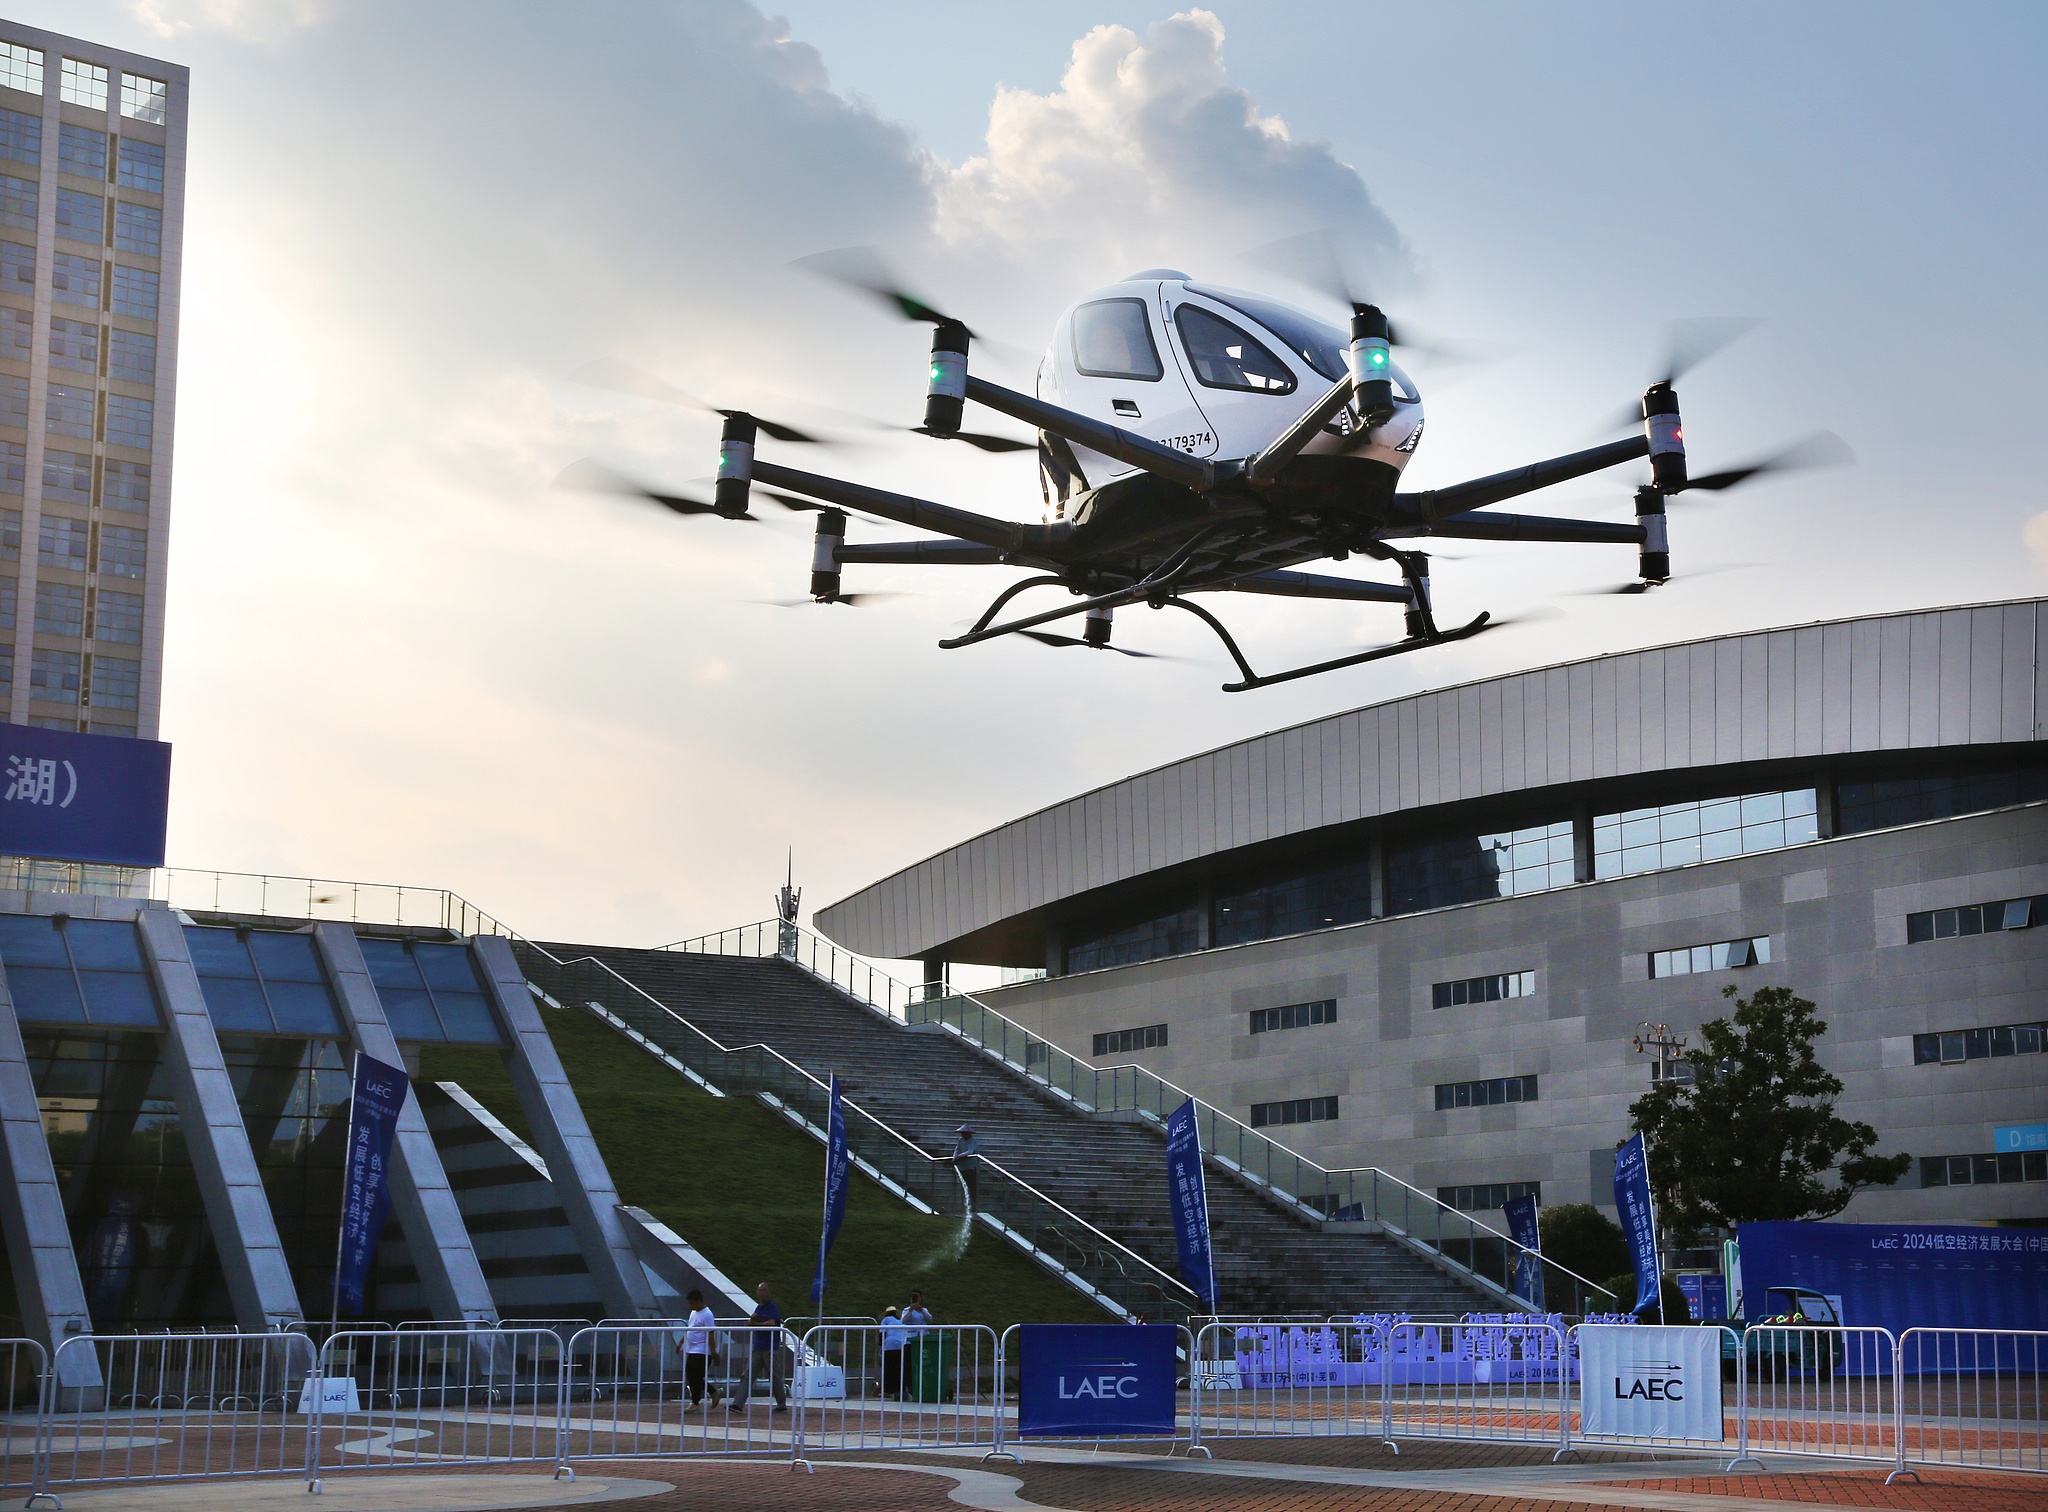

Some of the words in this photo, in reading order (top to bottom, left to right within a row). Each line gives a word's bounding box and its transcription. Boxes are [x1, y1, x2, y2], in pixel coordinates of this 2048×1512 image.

[366, 1079, 392, 1099] LAEC
[1172, 1119, 1188, 1137] LAEC
[2010, 1130, 2021, 1148] D
[1620, 1151, 1638, 1168] LAEC
[347, 1126, 371, 1239] 发展低空经济
[1175, 1162, 1200, 1255] 发展低空经济
[1513, 1206, 1529, 1216] LAEC
[1190, 1174, 1210, 1263] 创享美好未
[1871, 1238, 1899, 1249] LAEC
[1059, 1376, 1139, 1399] LAEC
[1615, 1377, 1684, 1401] LAEC
[323, 1394, 346, 1402] LAEC
